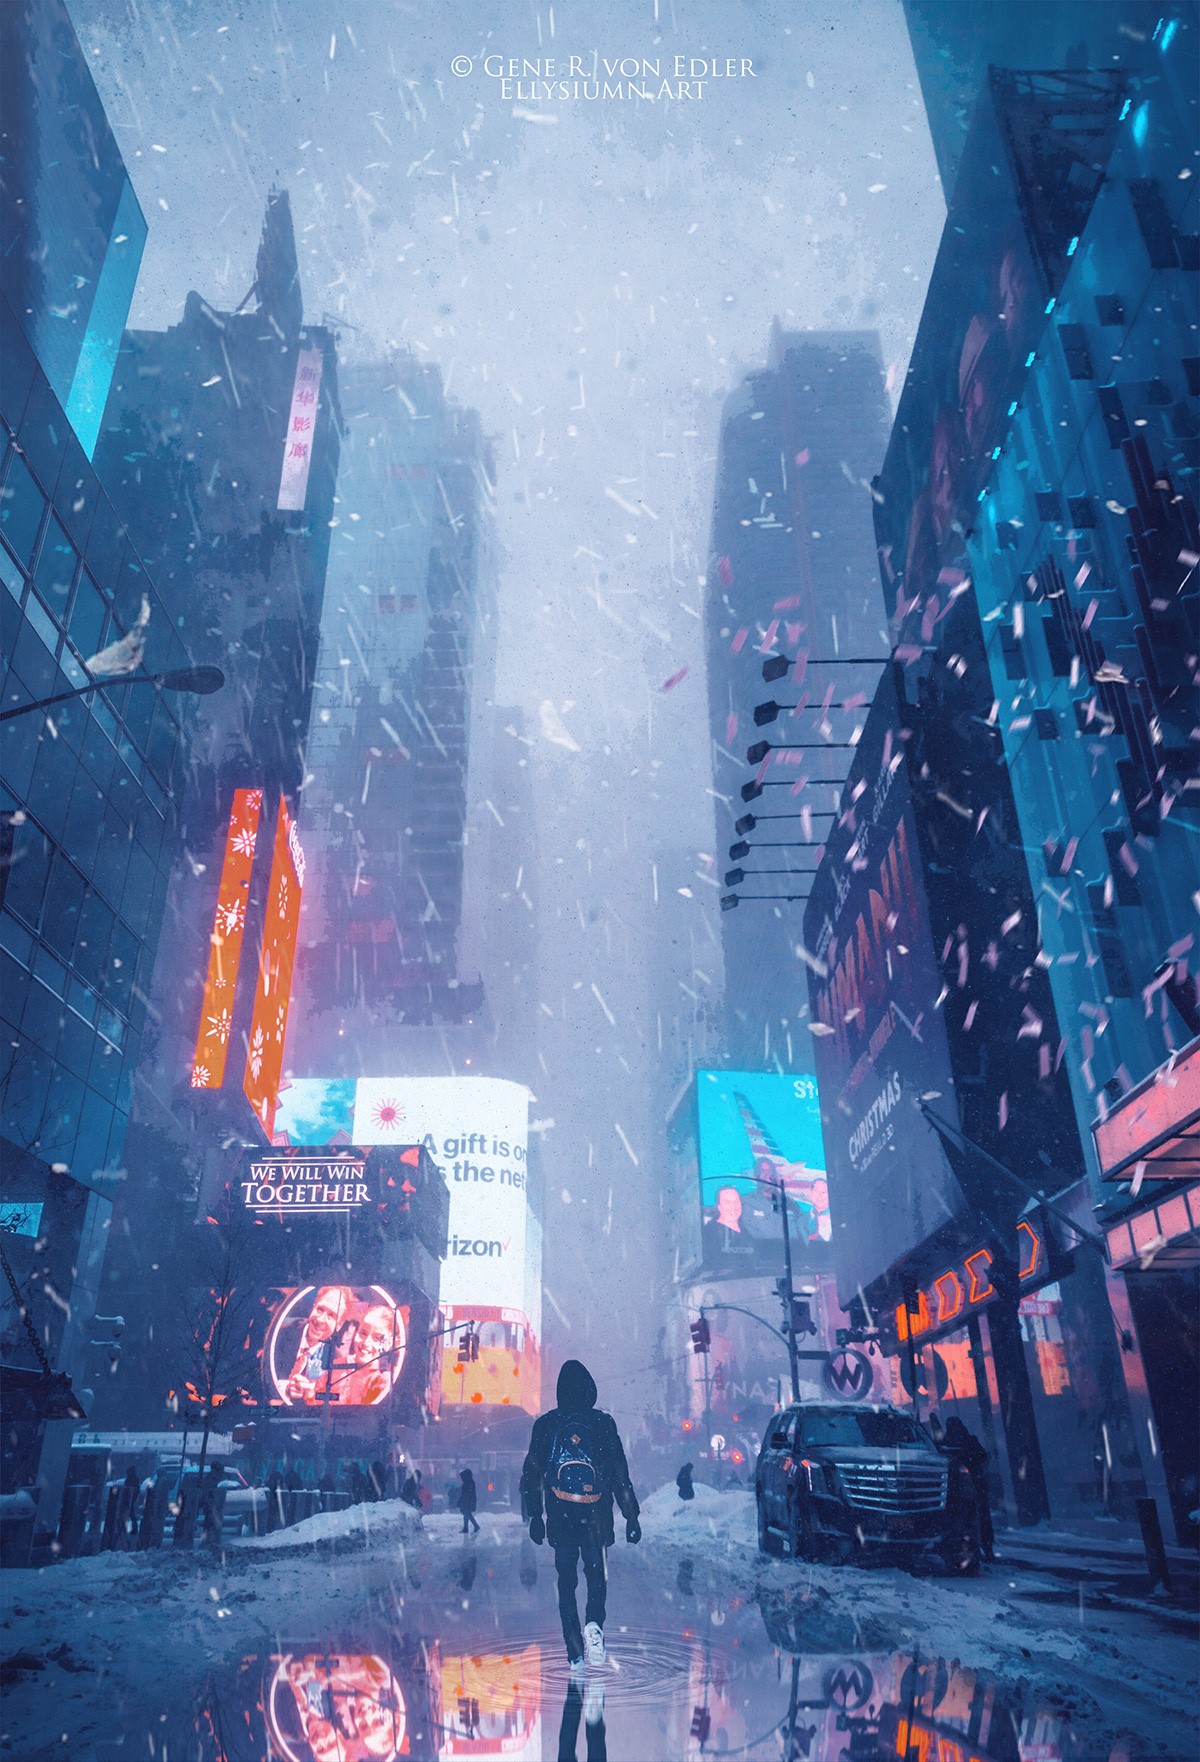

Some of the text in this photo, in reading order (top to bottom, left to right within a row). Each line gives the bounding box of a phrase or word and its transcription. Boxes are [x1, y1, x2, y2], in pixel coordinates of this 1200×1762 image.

[849, 1071, 901, 1162] CHRISTMAS
[421, 1133, 437, 1155] A
[443, 1133, 487, 1159] gift
[492, 1135, 510, 1158] is
[250, 1165, 364, 1181] WE WILL WIN
[452, 1160, 495, 1183] the
[241, 1182, 371, 1204] TOGETHER
[446, 1234, 501, 1258] rizon
